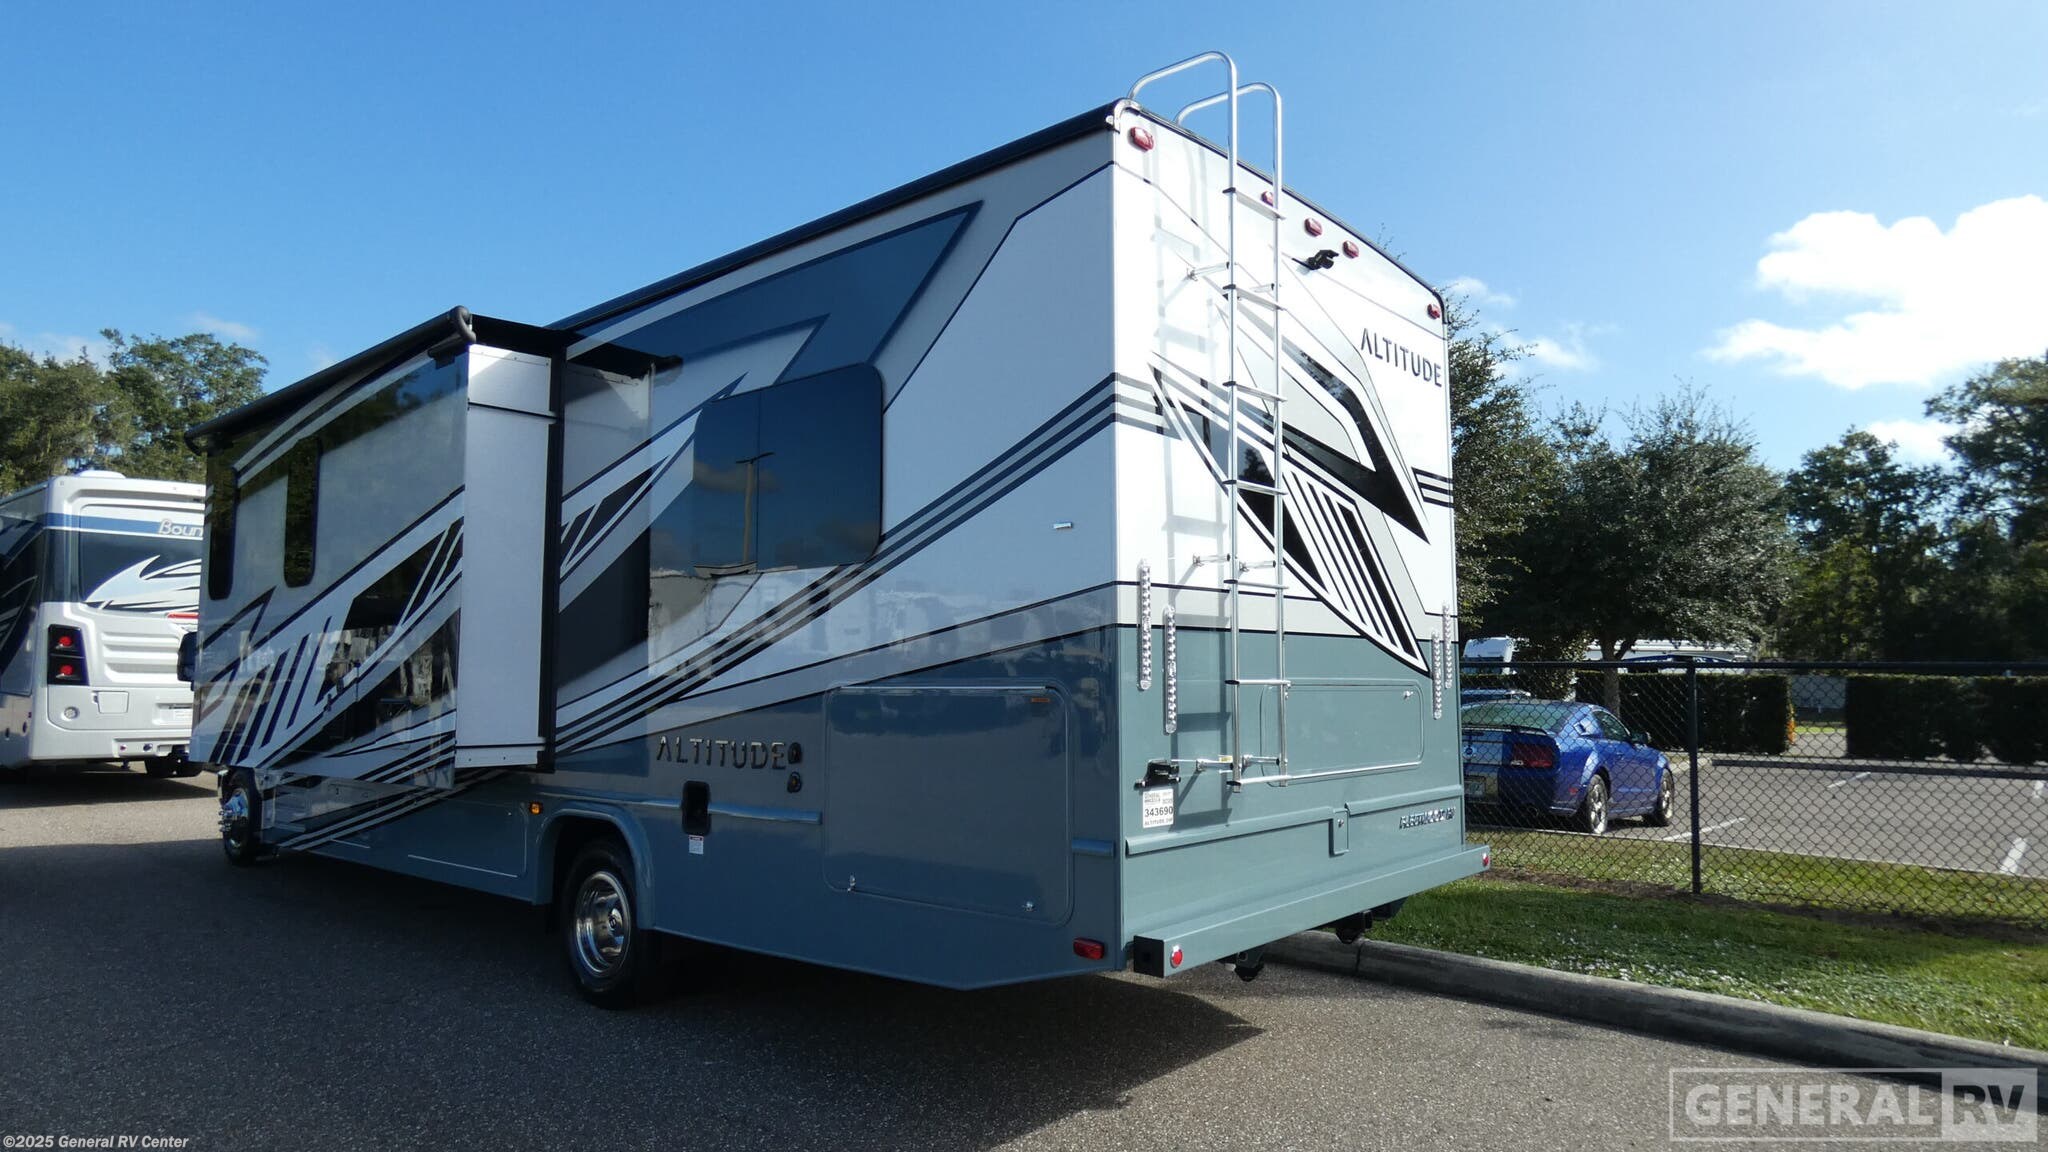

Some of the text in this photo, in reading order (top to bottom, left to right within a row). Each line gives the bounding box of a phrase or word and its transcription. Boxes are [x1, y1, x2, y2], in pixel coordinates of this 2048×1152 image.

[1360, 327, 1442, 388] ALTITUDE
[656, 735, 787, 770] ALTITUDE
[1144, 806, 1174, 817] 343690
